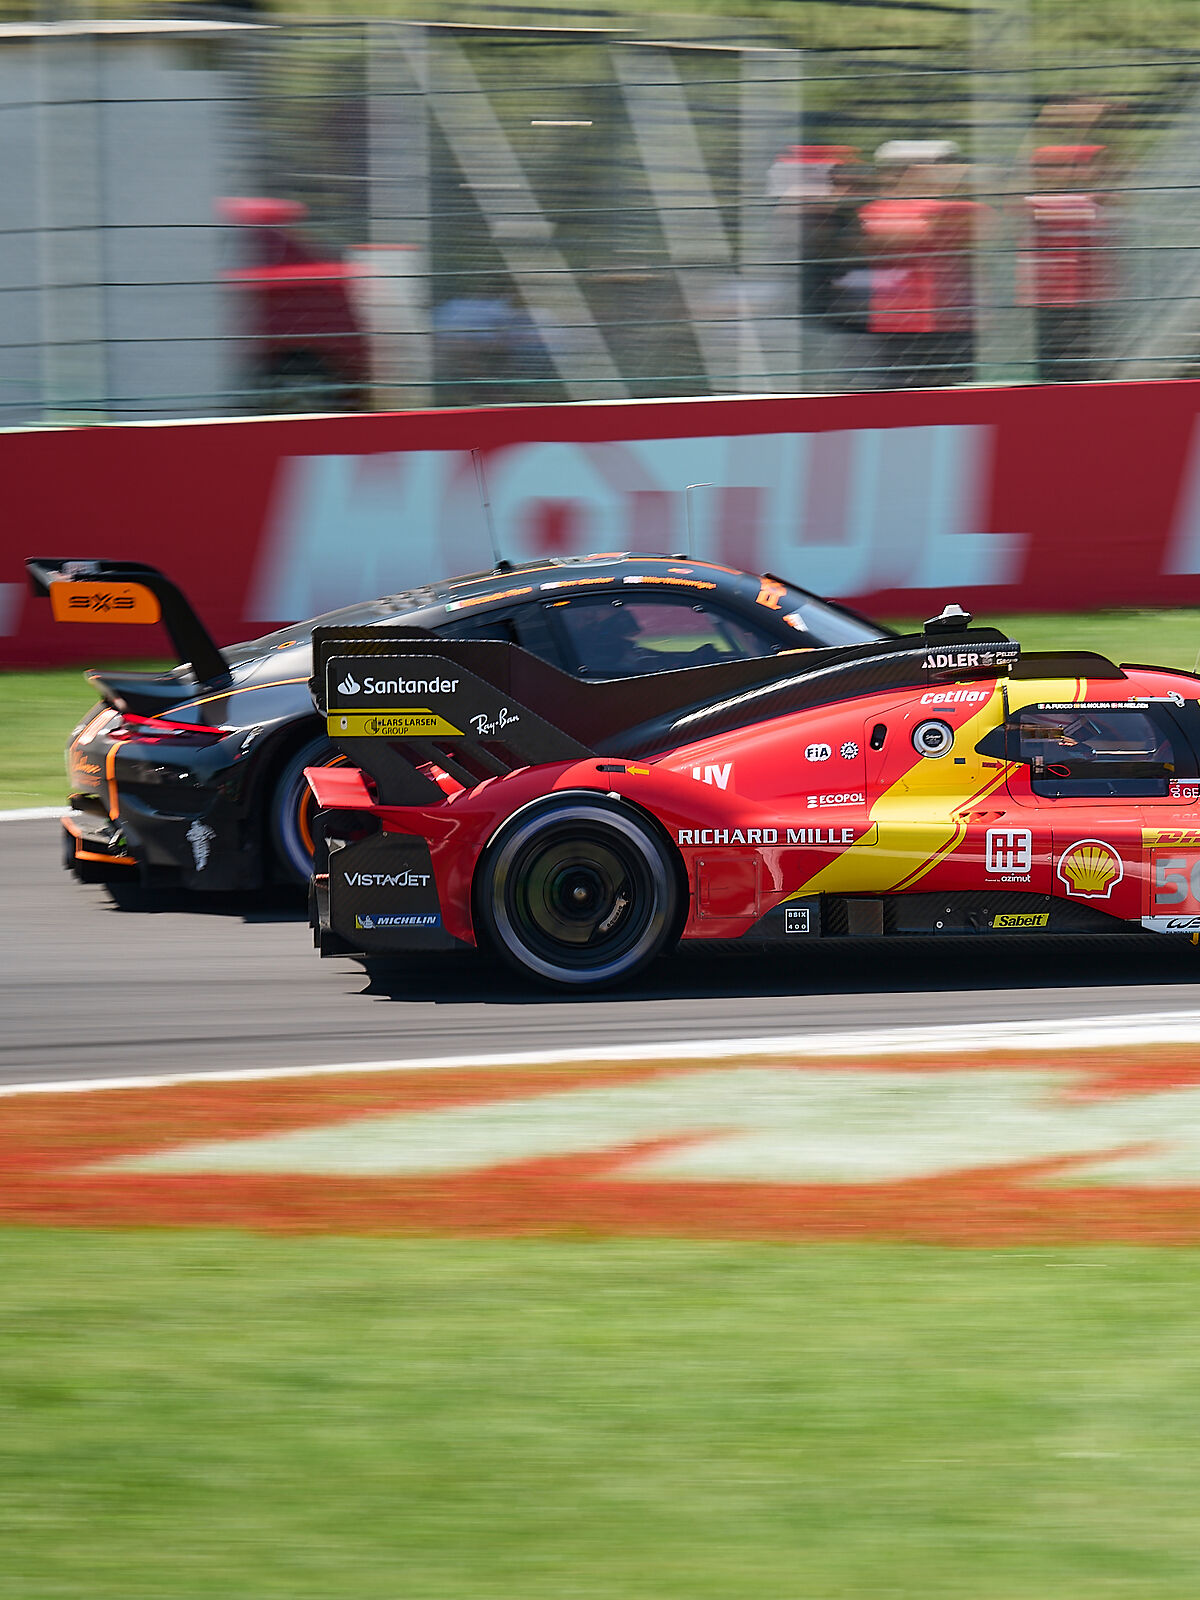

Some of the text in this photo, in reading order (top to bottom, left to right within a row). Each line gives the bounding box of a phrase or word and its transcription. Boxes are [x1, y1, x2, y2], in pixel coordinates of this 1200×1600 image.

[246, 424, 1030, 622] MOTUL
[922, 653, 979, 668] ADLER
[363, 677, 459, 694] Santander
[382, 718, 437, 726] LARS LARSEN
[382, 727, 409, 735] GROUP
[819, 793, 865, 804] ECOPOL
[678, 828, 854, 845] RICHARD MILLE
[1001, 873, 1031, 882] azimut
[377, 916, 436, 925] MICHELIN
[998, 915, 1044, 927] Sabelt
